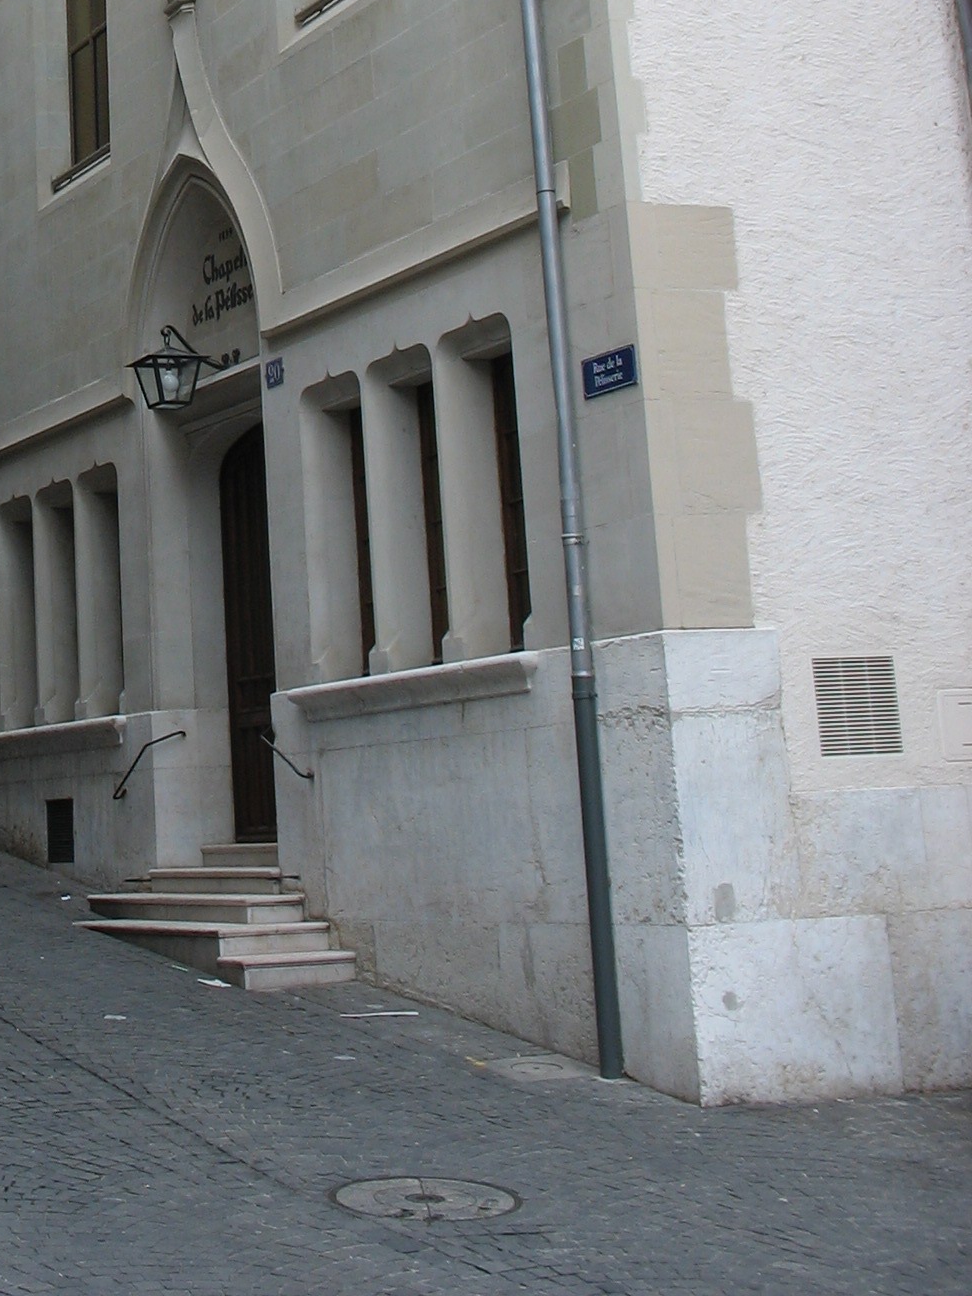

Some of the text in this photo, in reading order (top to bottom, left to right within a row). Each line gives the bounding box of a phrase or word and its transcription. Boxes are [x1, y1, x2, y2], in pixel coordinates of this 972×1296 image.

[192, 282, 254, 326] de la Pélisse
[593, 355, 622, 374] Rue de la
